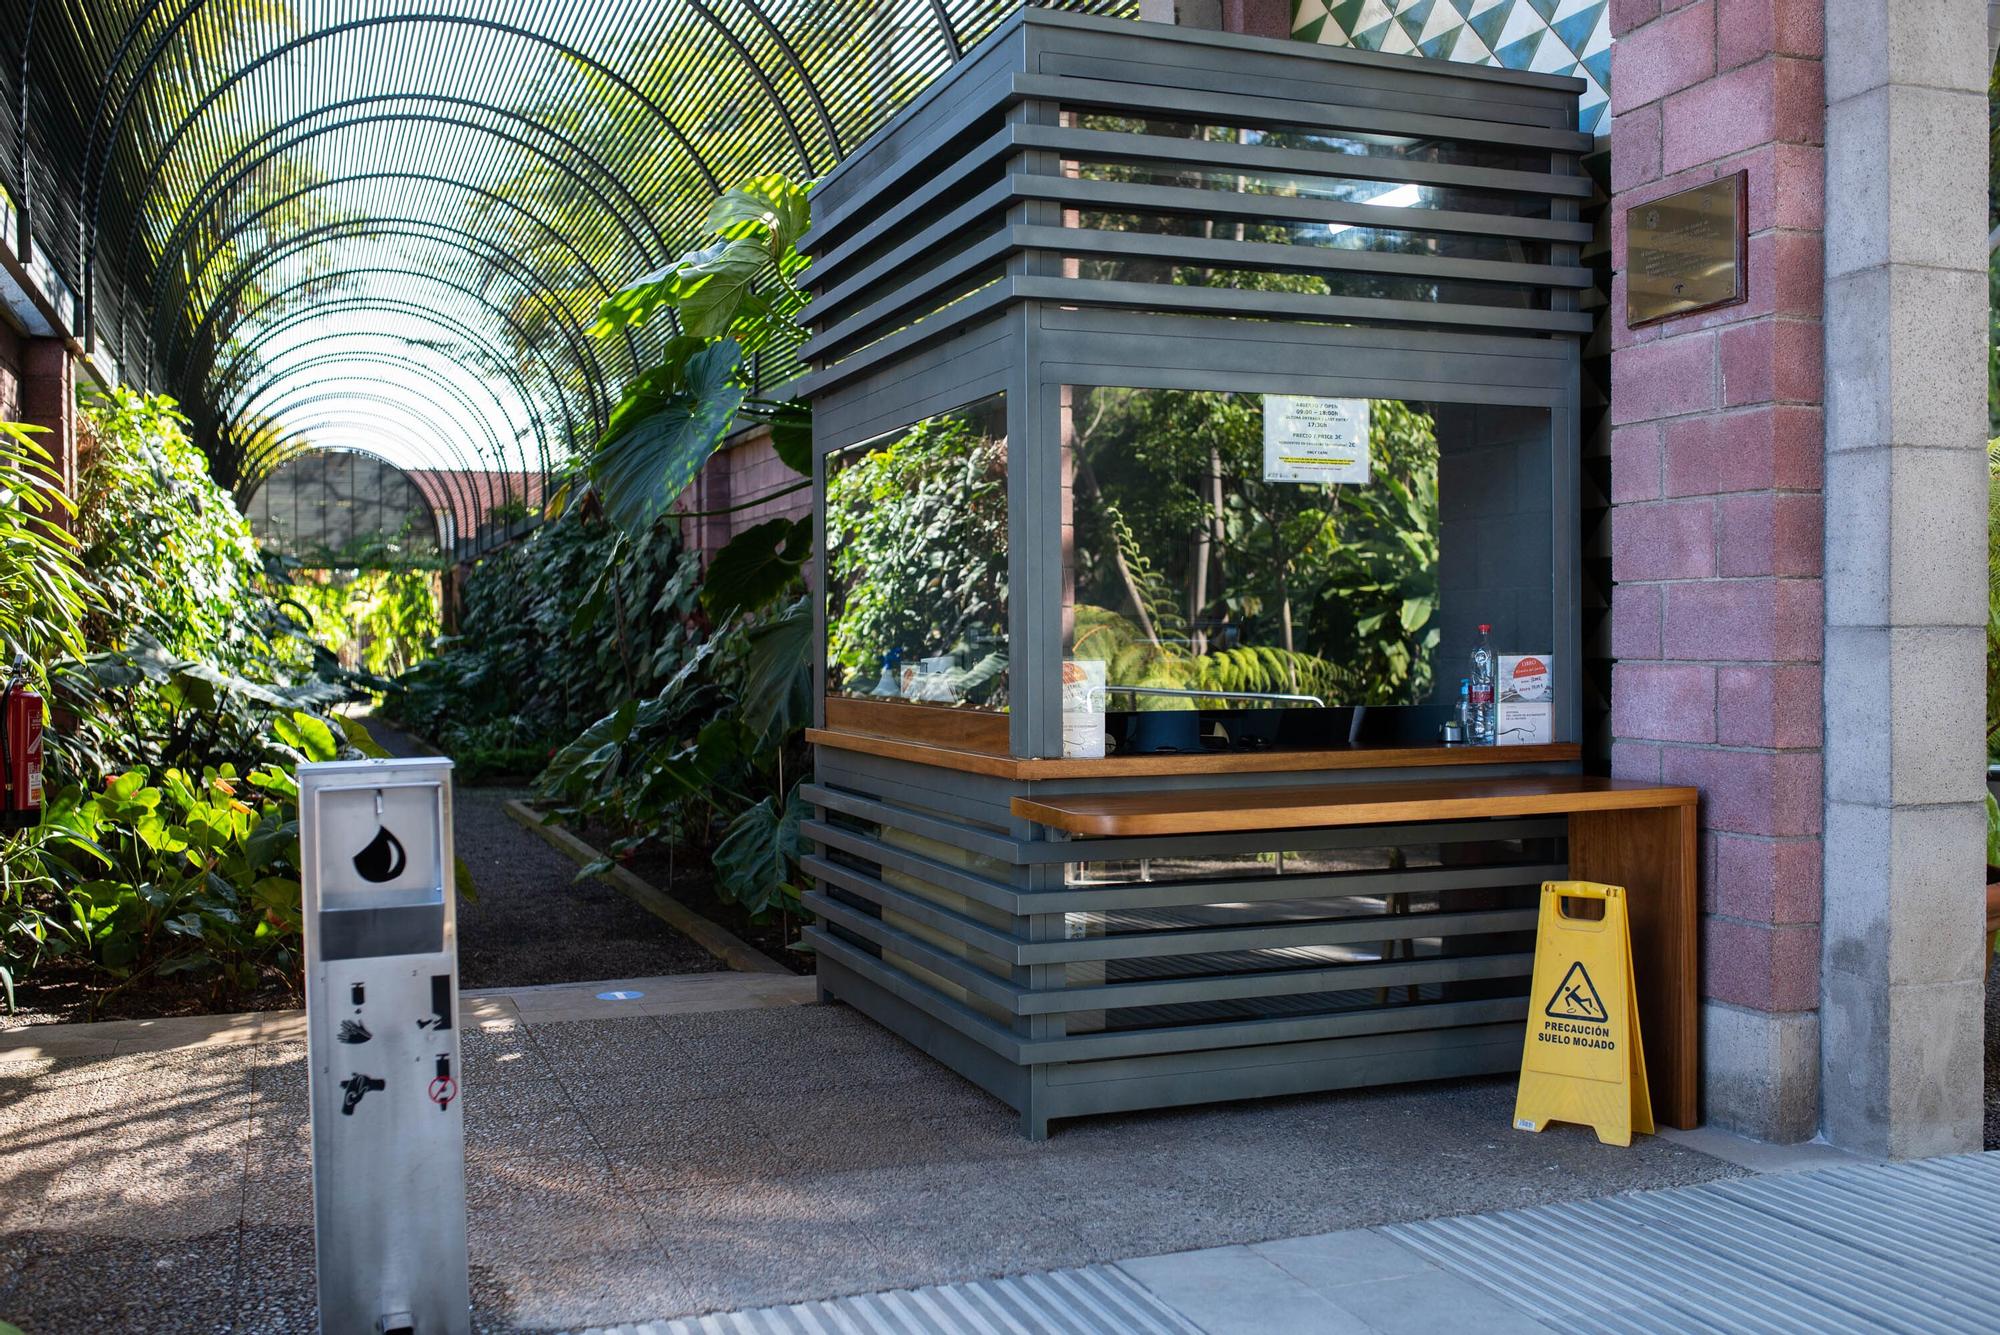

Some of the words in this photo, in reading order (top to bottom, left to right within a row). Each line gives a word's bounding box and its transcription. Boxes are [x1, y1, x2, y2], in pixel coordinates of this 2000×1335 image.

[1544, 1021, 1609, 1037] PRECAUCIÓN
[1538, 1032, 1571, 1045] SUELO
[1572, 1036, 1615, 1050] MOJADO
